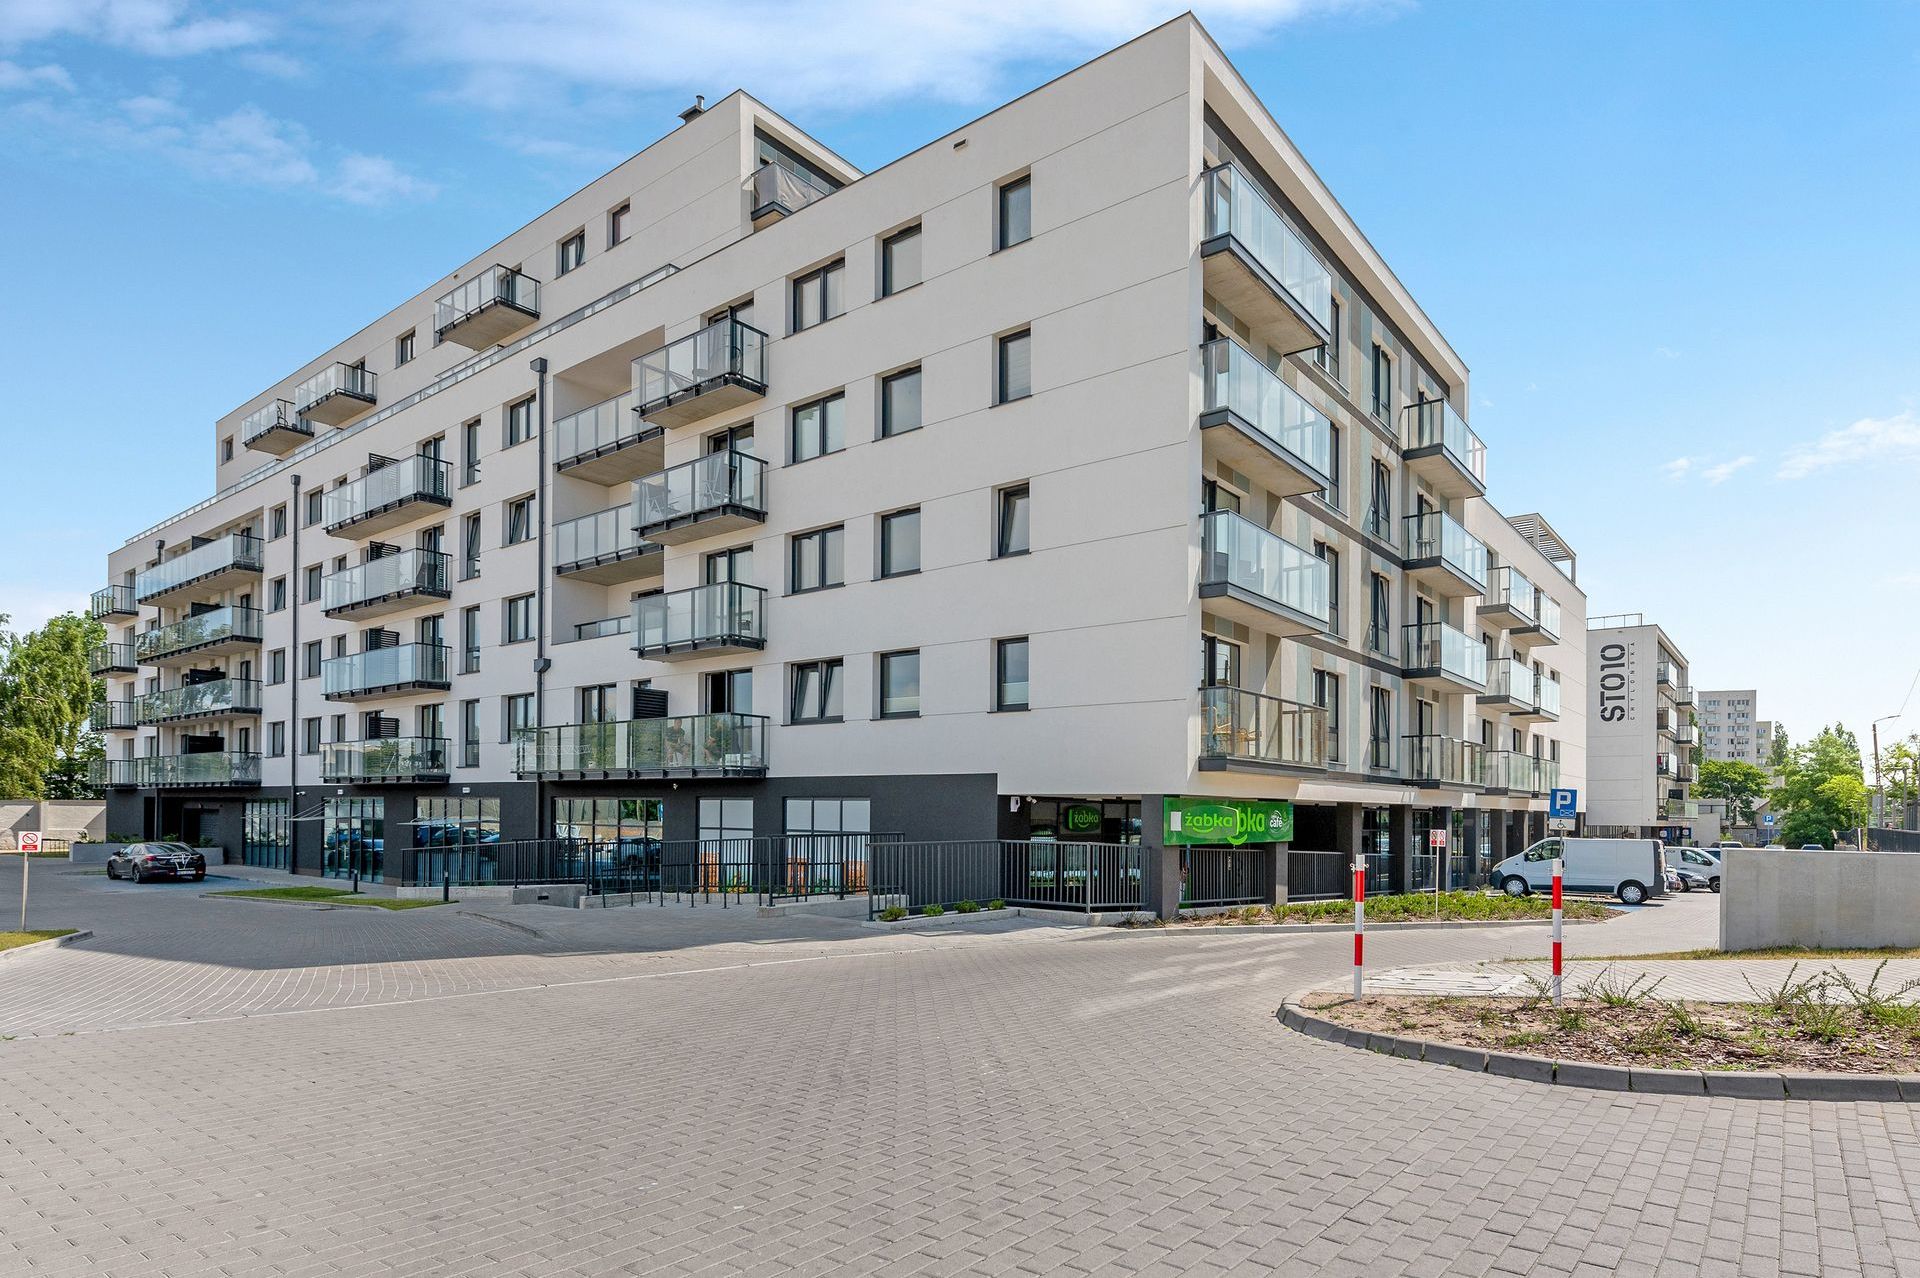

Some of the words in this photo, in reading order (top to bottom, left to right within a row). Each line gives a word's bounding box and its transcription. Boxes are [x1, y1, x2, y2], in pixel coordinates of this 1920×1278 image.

[1556, 791, 1572, 810] P
[1074, 810, 1099, 823] żabka
[1185, 812, 1232, 827] żabka
